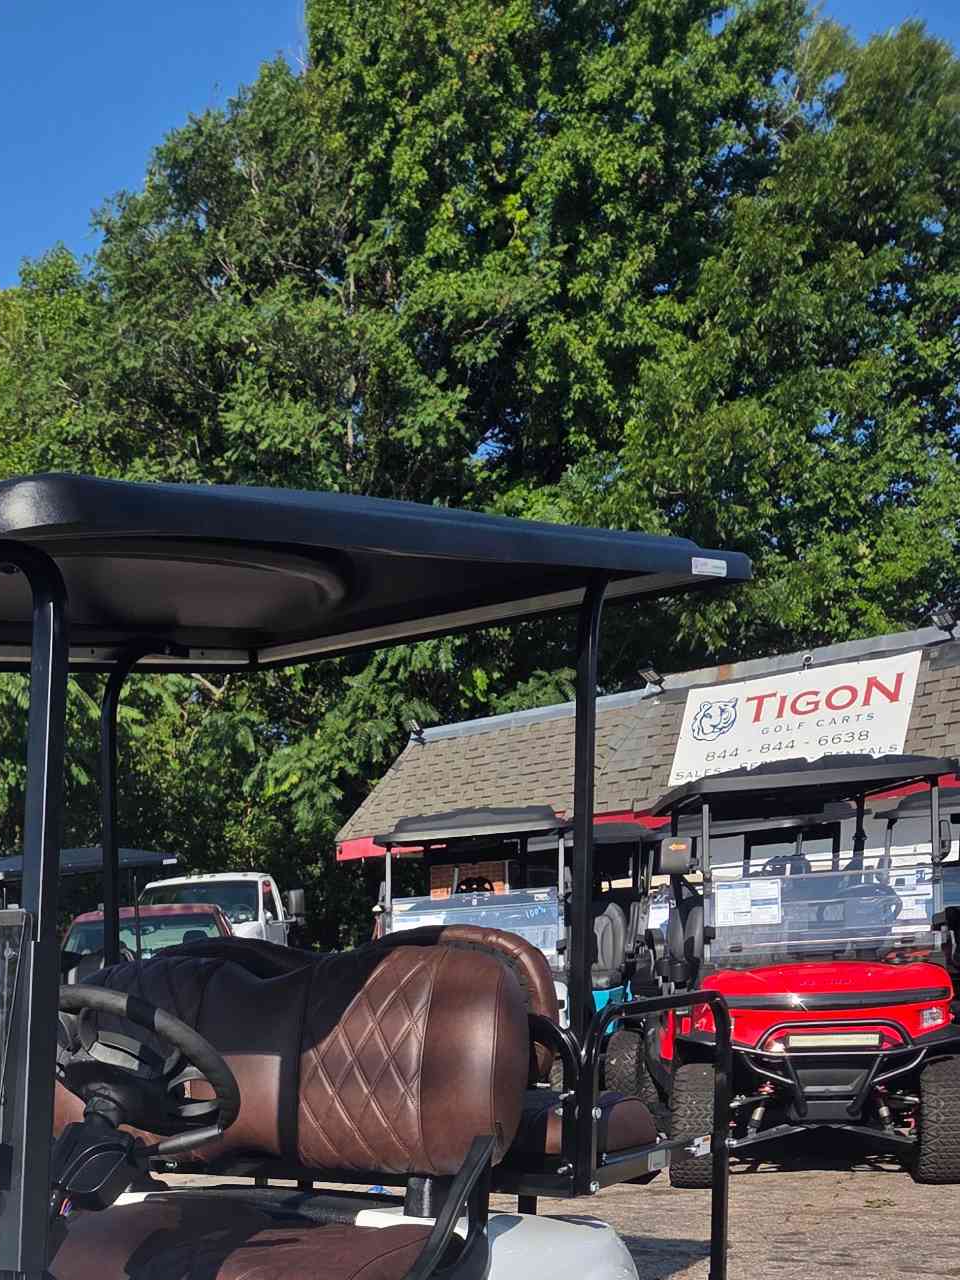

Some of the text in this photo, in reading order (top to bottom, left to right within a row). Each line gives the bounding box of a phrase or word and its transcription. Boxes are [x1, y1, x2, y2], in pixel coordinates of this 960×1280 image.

[745, 672, 905, 724] TIGON
[761, 712, 876, 735] GOLF CARTS
[704, 747, 739, 762] 844
[760, 738, 796, 754] 844
[817, 729, 870, 747] 6638
[674, 767, 722, 780] SALES
